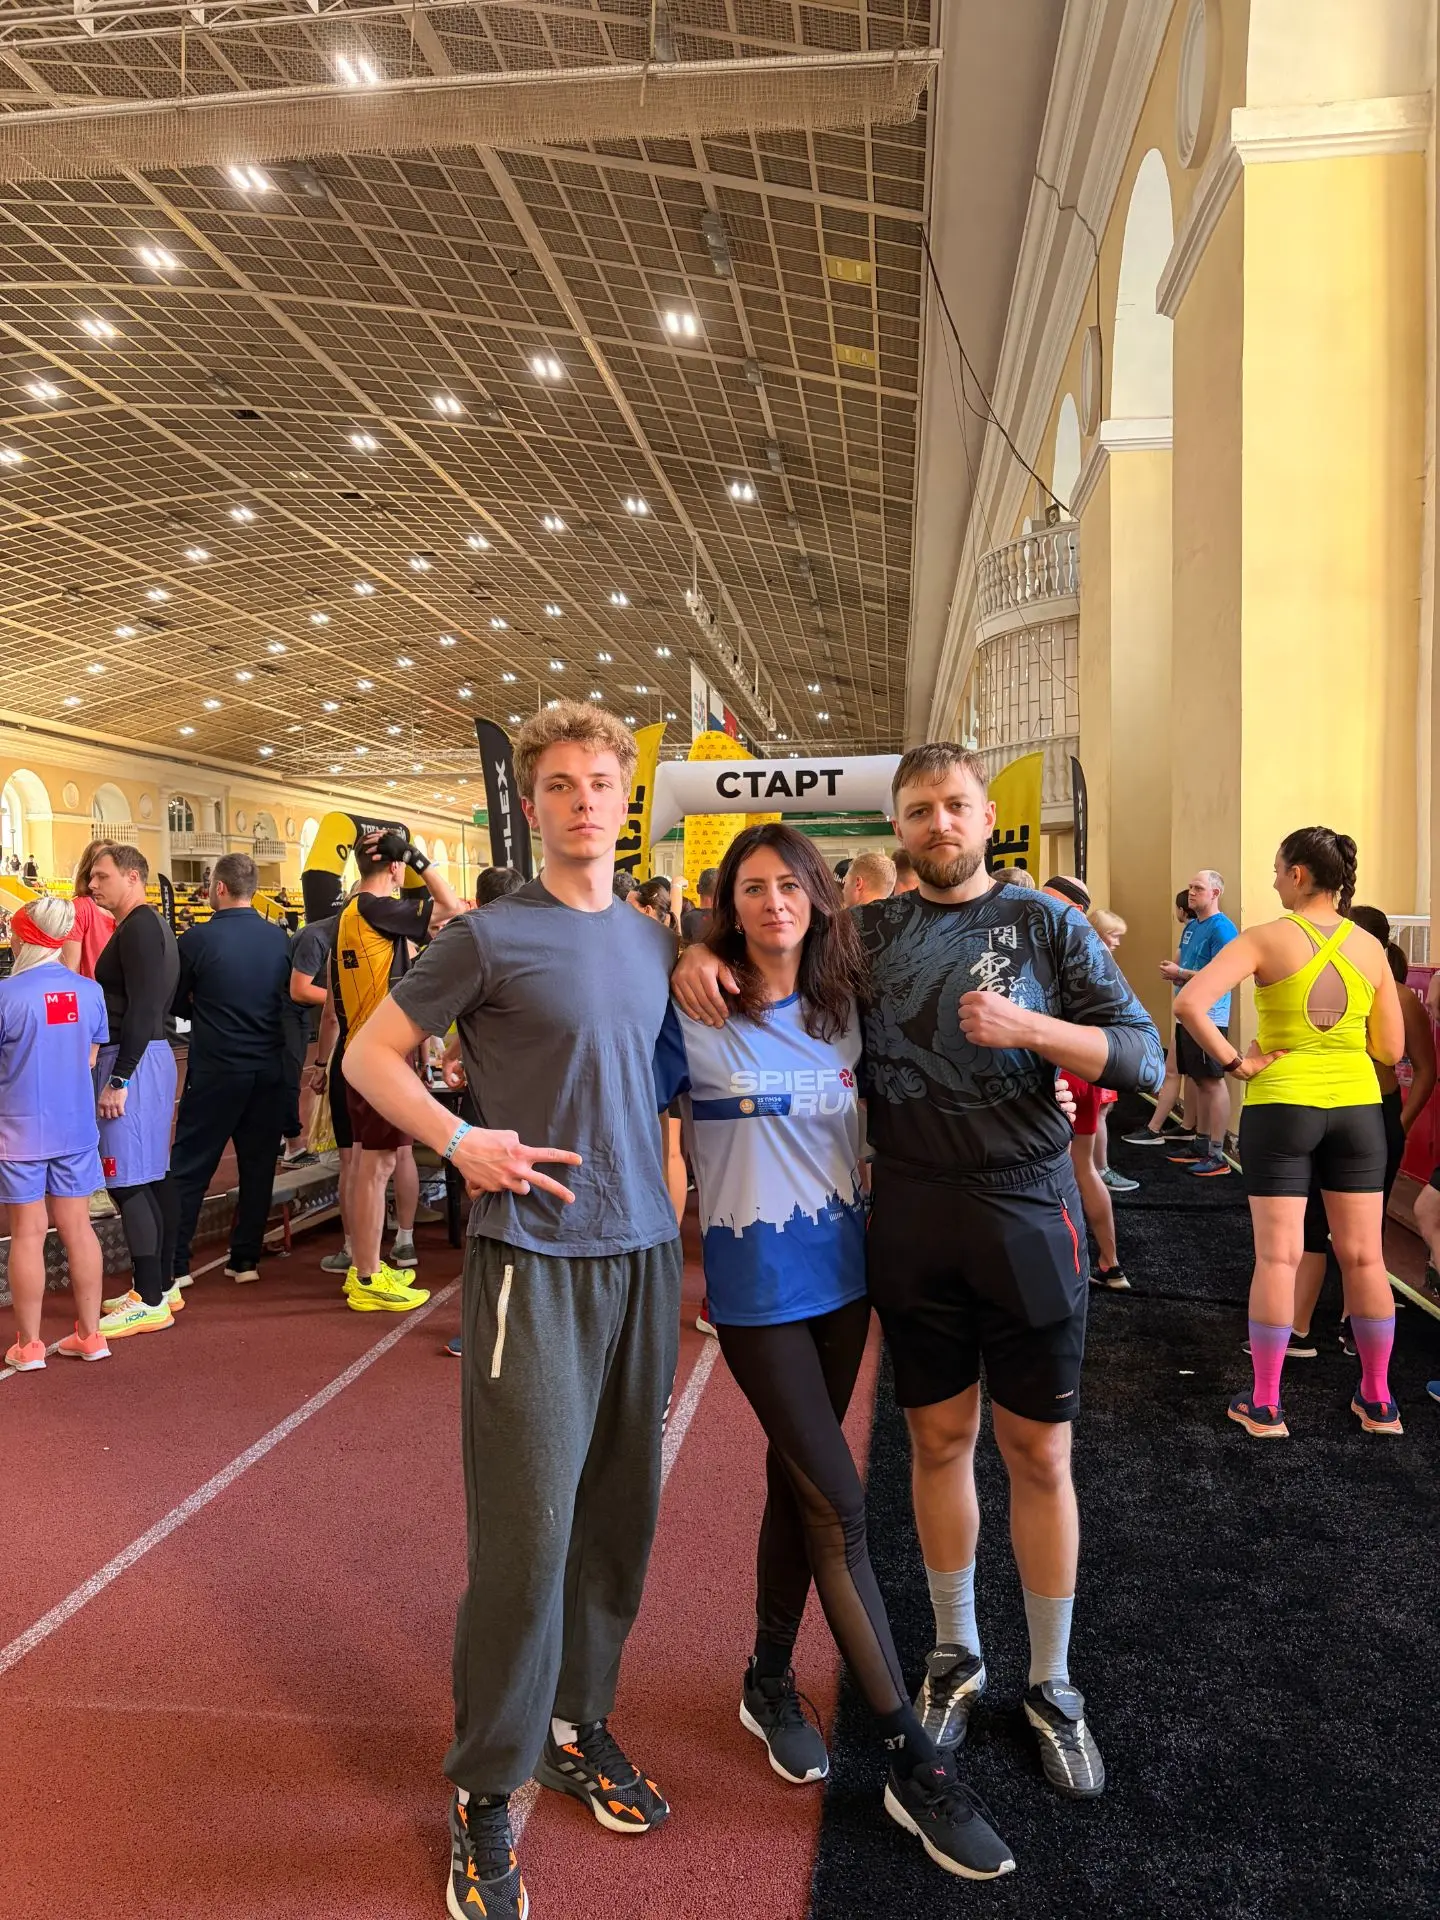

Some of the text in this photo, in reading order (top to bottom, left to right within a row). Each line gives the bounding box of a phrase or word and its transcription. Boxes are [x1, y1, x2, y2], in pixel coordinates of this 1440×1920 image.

[716, 769, 844, 799] СТАРТ
[729, 1069, 837, 1094] SPIEF
[884, 1734, 905, 1750] 37
